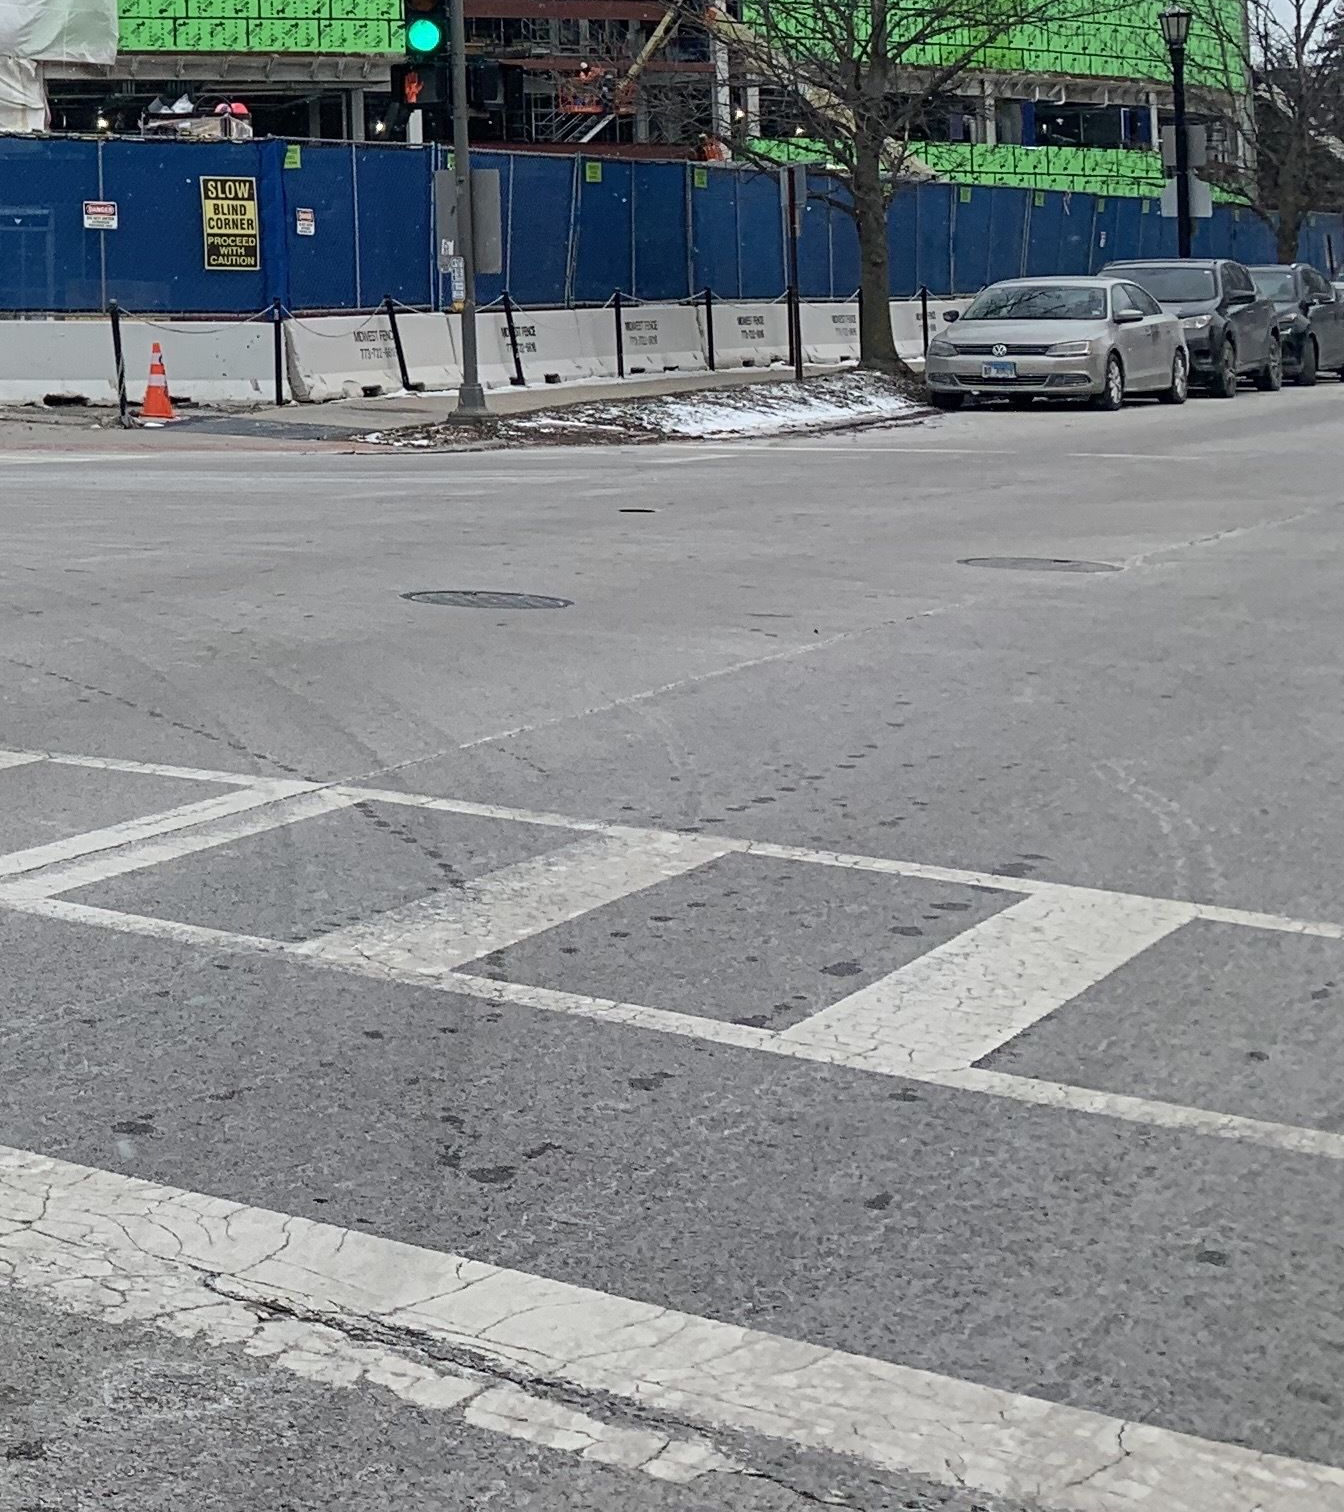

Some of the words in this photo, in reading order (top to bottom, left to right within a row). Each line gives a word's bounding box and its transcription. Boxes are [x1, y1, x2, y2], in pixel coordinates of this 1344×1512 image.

[207, 181, 250, 199] SLOW
[213, 203, 247, 216] BLIND
[207, 217, 254, 231] CORNER
[207, 236, 256, 247] PROCEED
[219, 246, 246, 256] WITH
[209, 255, 255, 266] CAUTION
[353, 330, 377, 342] MIDWEST
[379, 329, 395, 341] FENC
